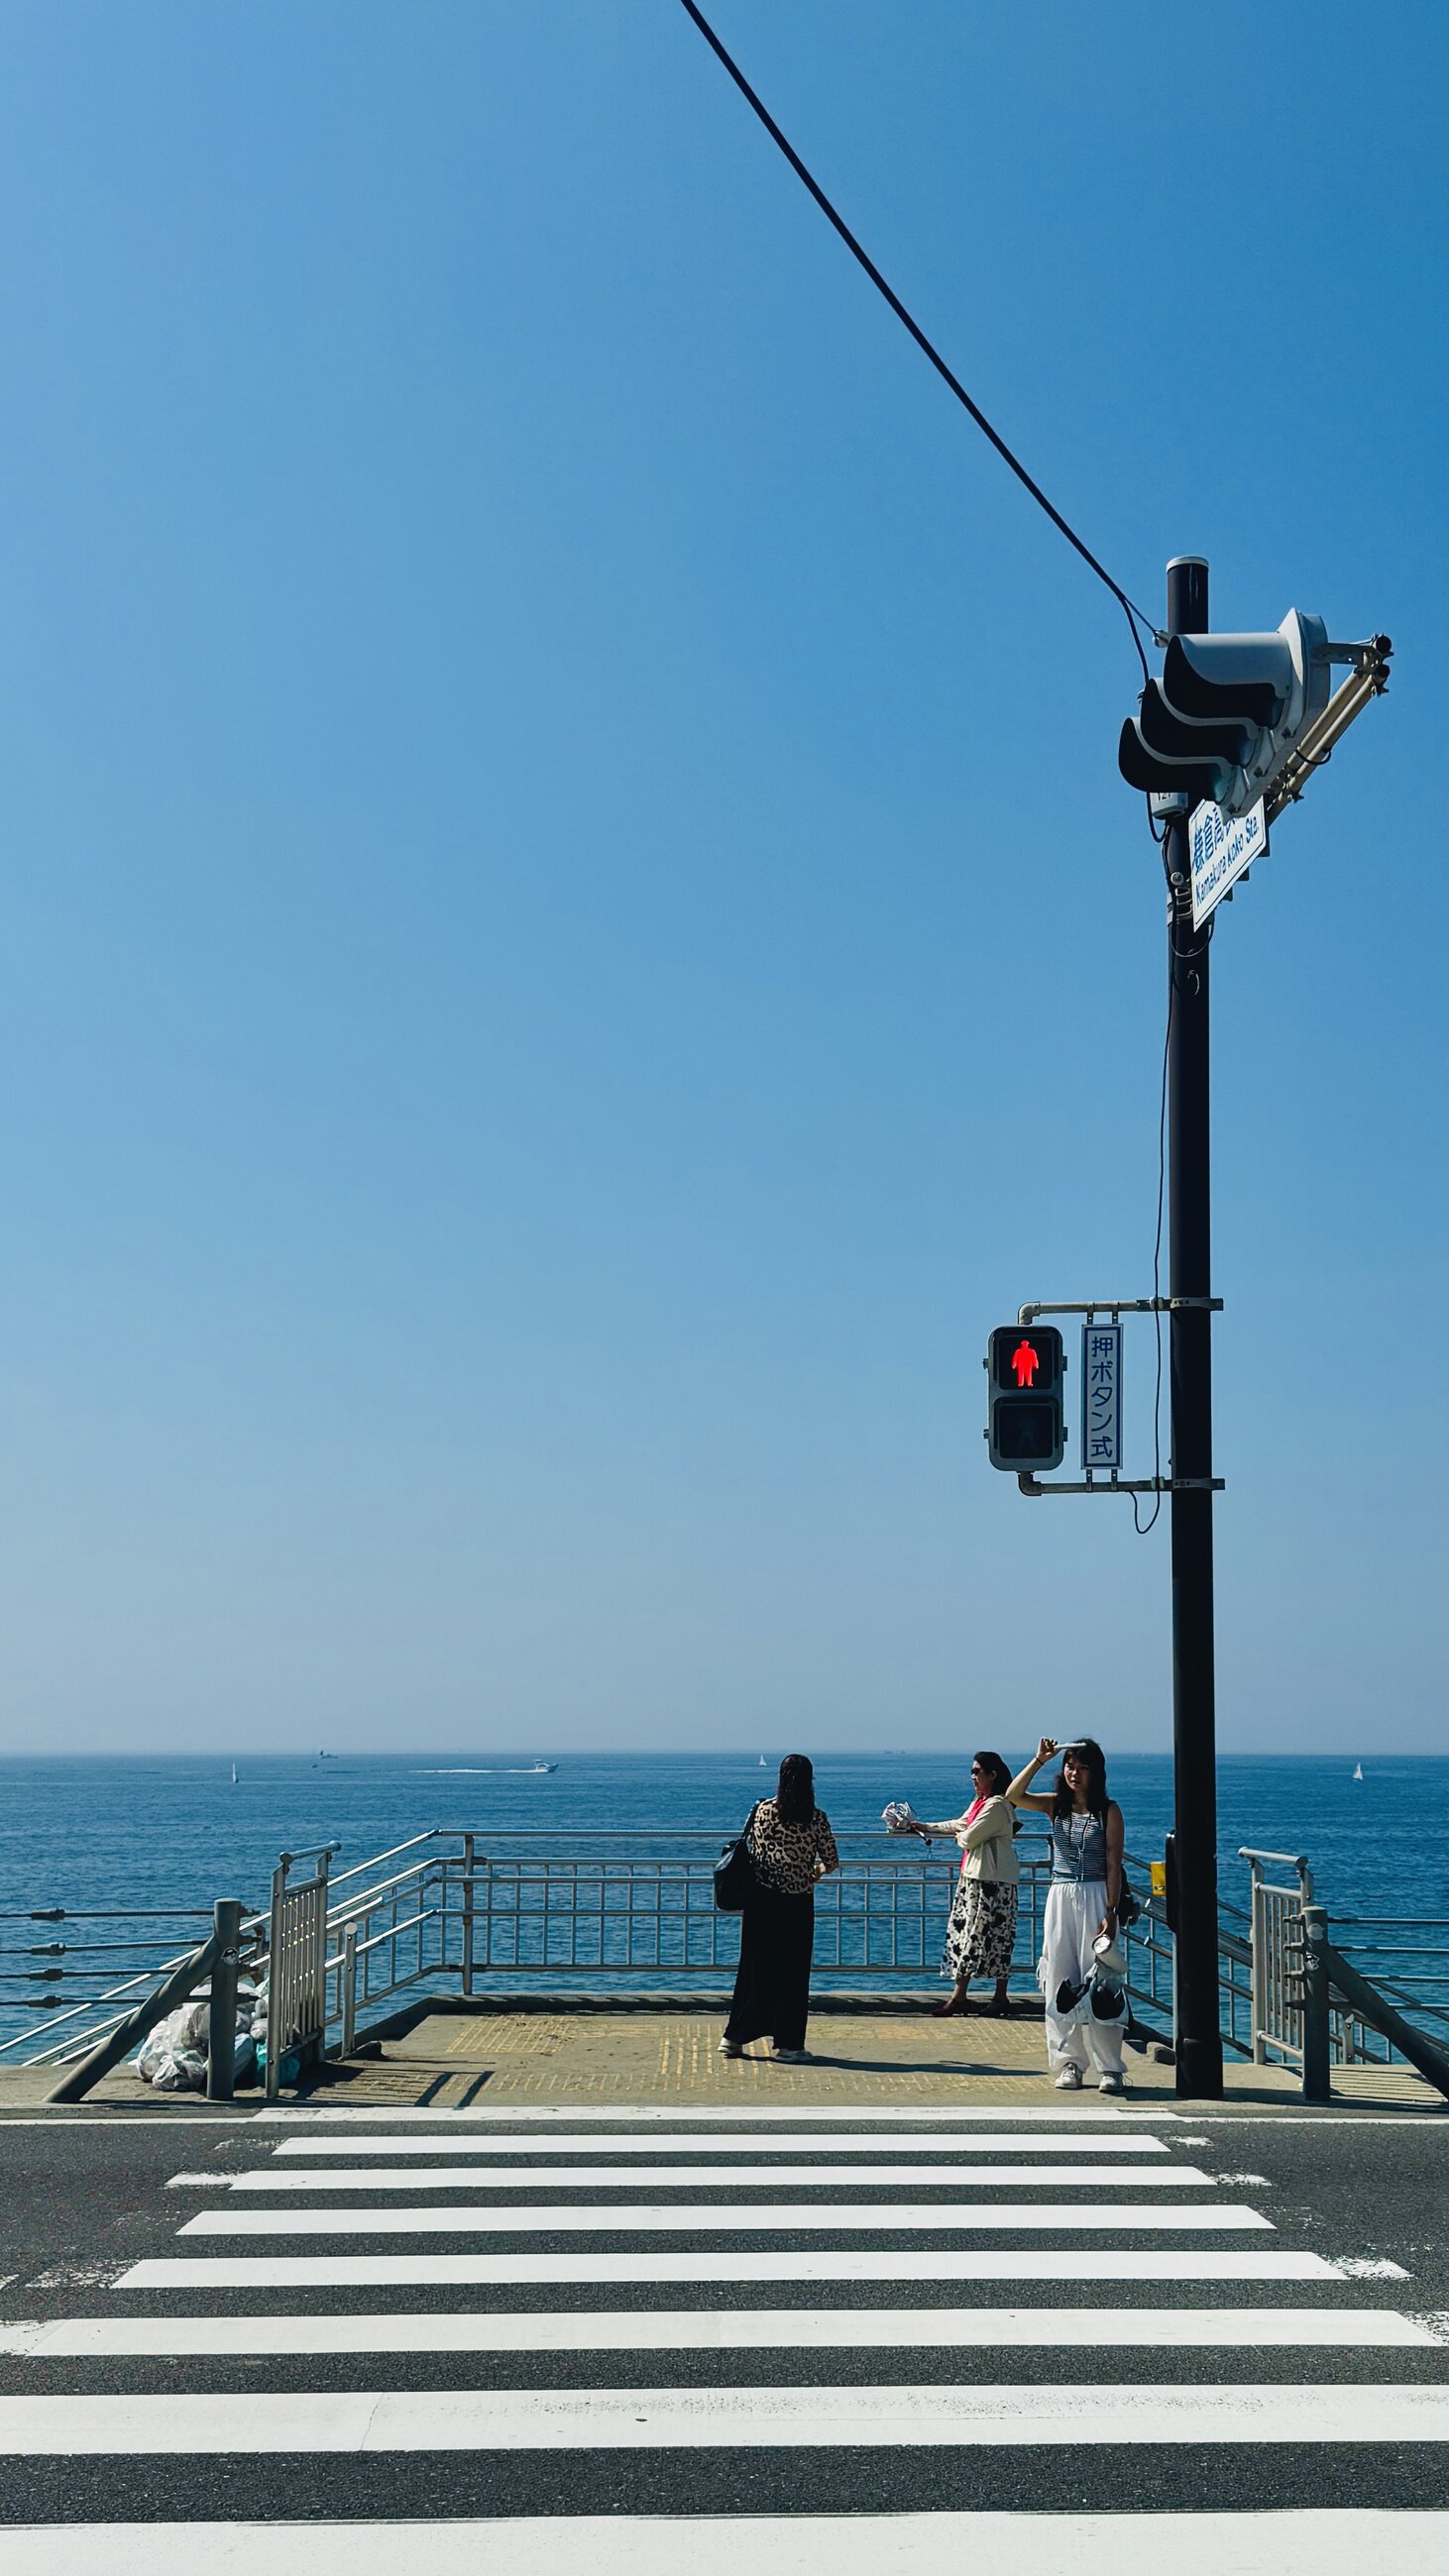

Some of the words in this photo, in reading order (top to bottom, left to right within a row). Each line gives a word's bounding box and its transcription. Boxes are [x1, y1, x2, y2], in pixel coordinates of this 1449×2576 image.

[1195, 855, 1227, 907] Kamakura
[1228, 833, 1244, 867] Koko
[1245, 815, 1259, 844] Sta.
[1091, 1336, 1113, 1457] 押ボタン式
